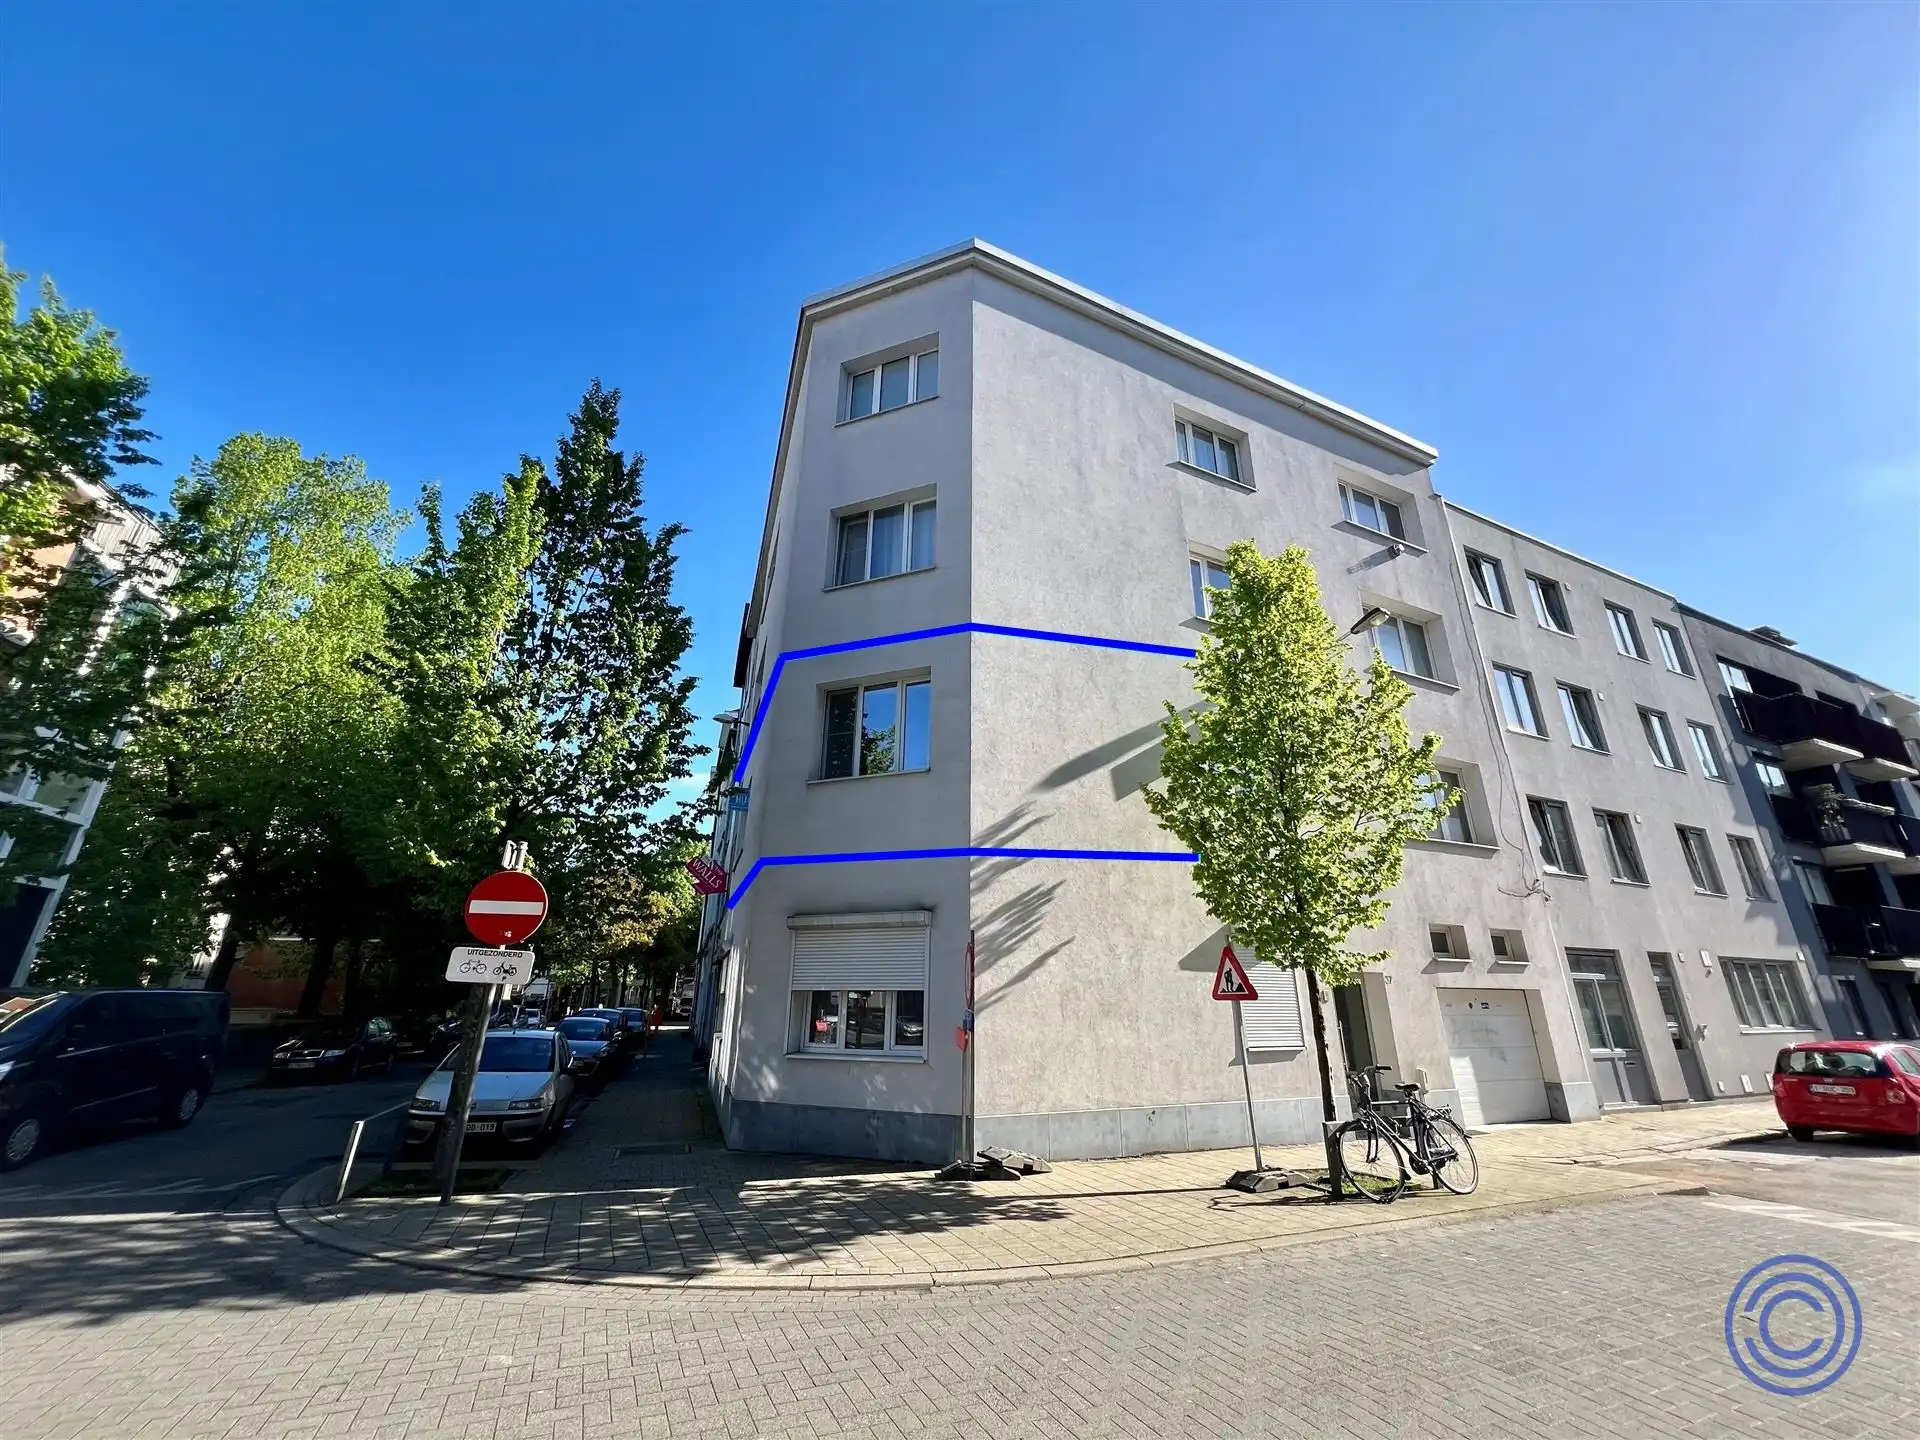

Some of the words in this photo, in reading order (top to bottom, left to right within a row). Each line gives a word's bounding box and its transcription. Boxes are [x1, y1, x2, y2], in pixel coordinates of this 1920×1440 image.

[692, 858, 722, 888] WALLS
[467, 949, 523, 958] UITGEZONDERD
[1384, 975, 1393, 985] 37
